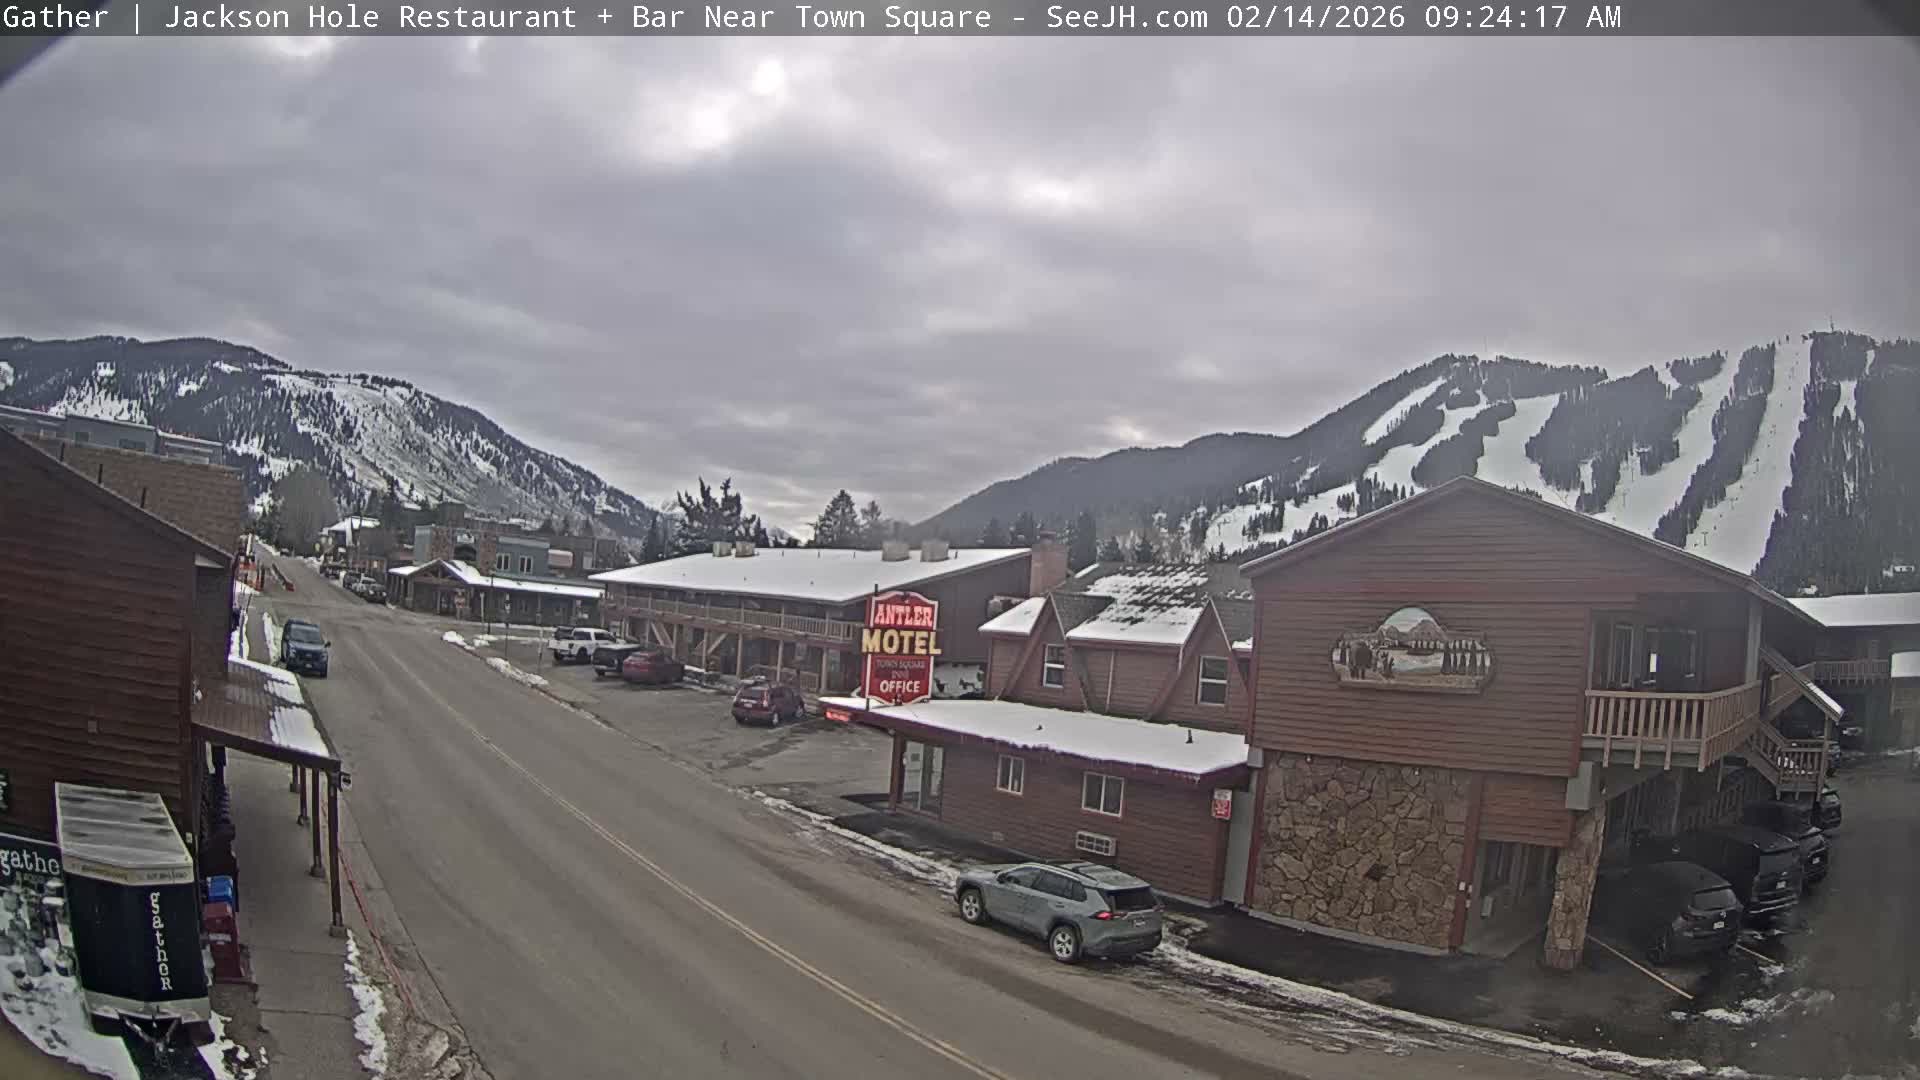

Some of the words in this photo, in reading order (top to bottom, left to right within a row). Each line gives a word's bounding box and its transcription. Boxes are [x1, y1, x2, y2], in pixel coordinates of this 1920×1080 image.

[874, 603, 933, 627] ANTLER
[861, 628, 942, 655] MOTEL
[879, 680, 921, 693] OFFICE
[0, 848, 60, 876] gathe
